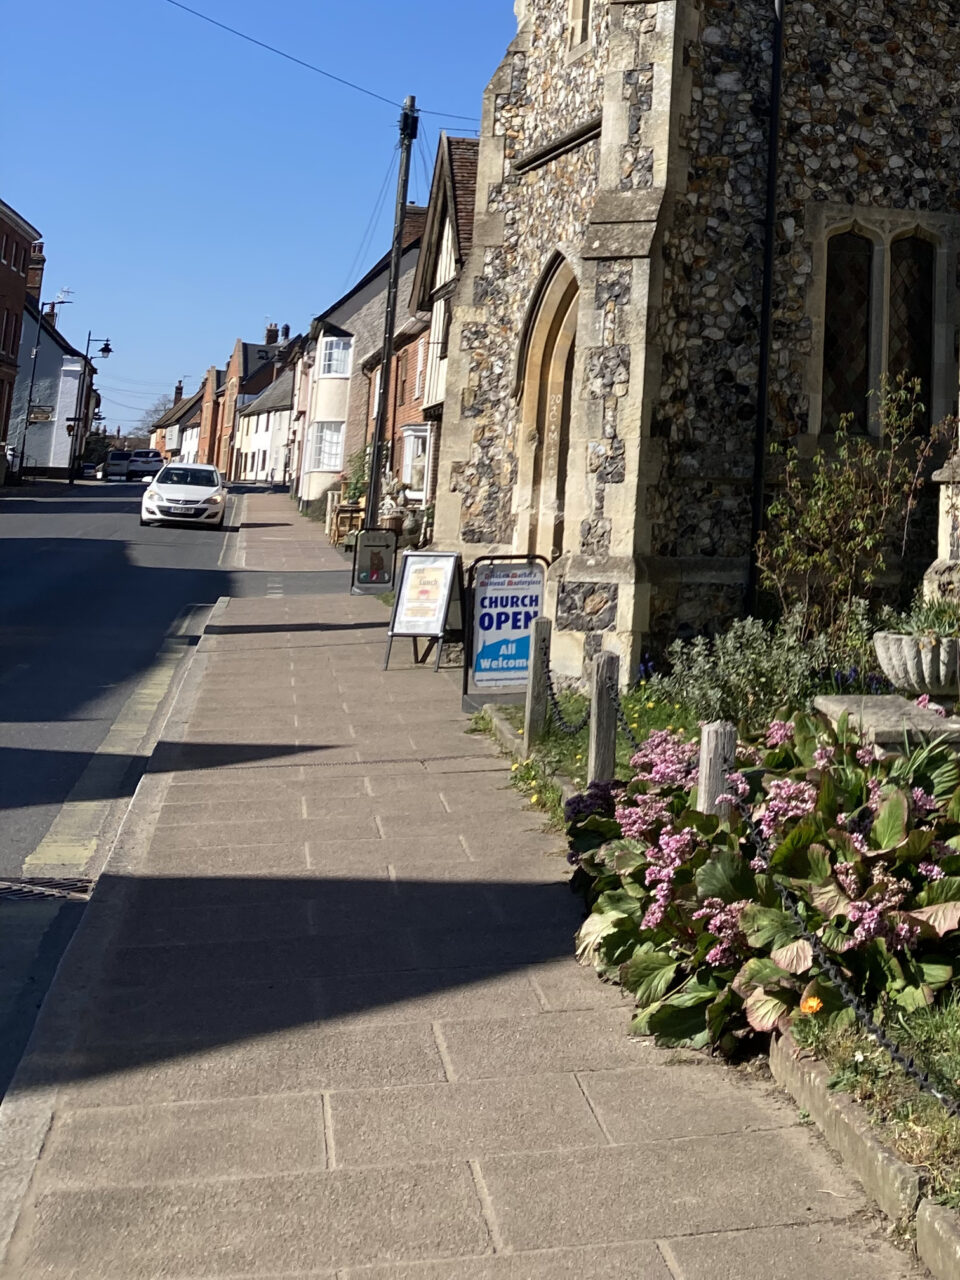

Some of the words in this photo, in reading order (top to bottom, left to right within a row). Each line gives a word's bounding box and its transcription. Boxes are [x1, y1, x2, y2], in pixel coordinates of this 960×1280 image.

[480, 594, 539, 609] CHURCH
[478, 610, 539, 631] OPEN
[499, 642, 516, 656] All
[480, 656, 528, 669] Welcom
